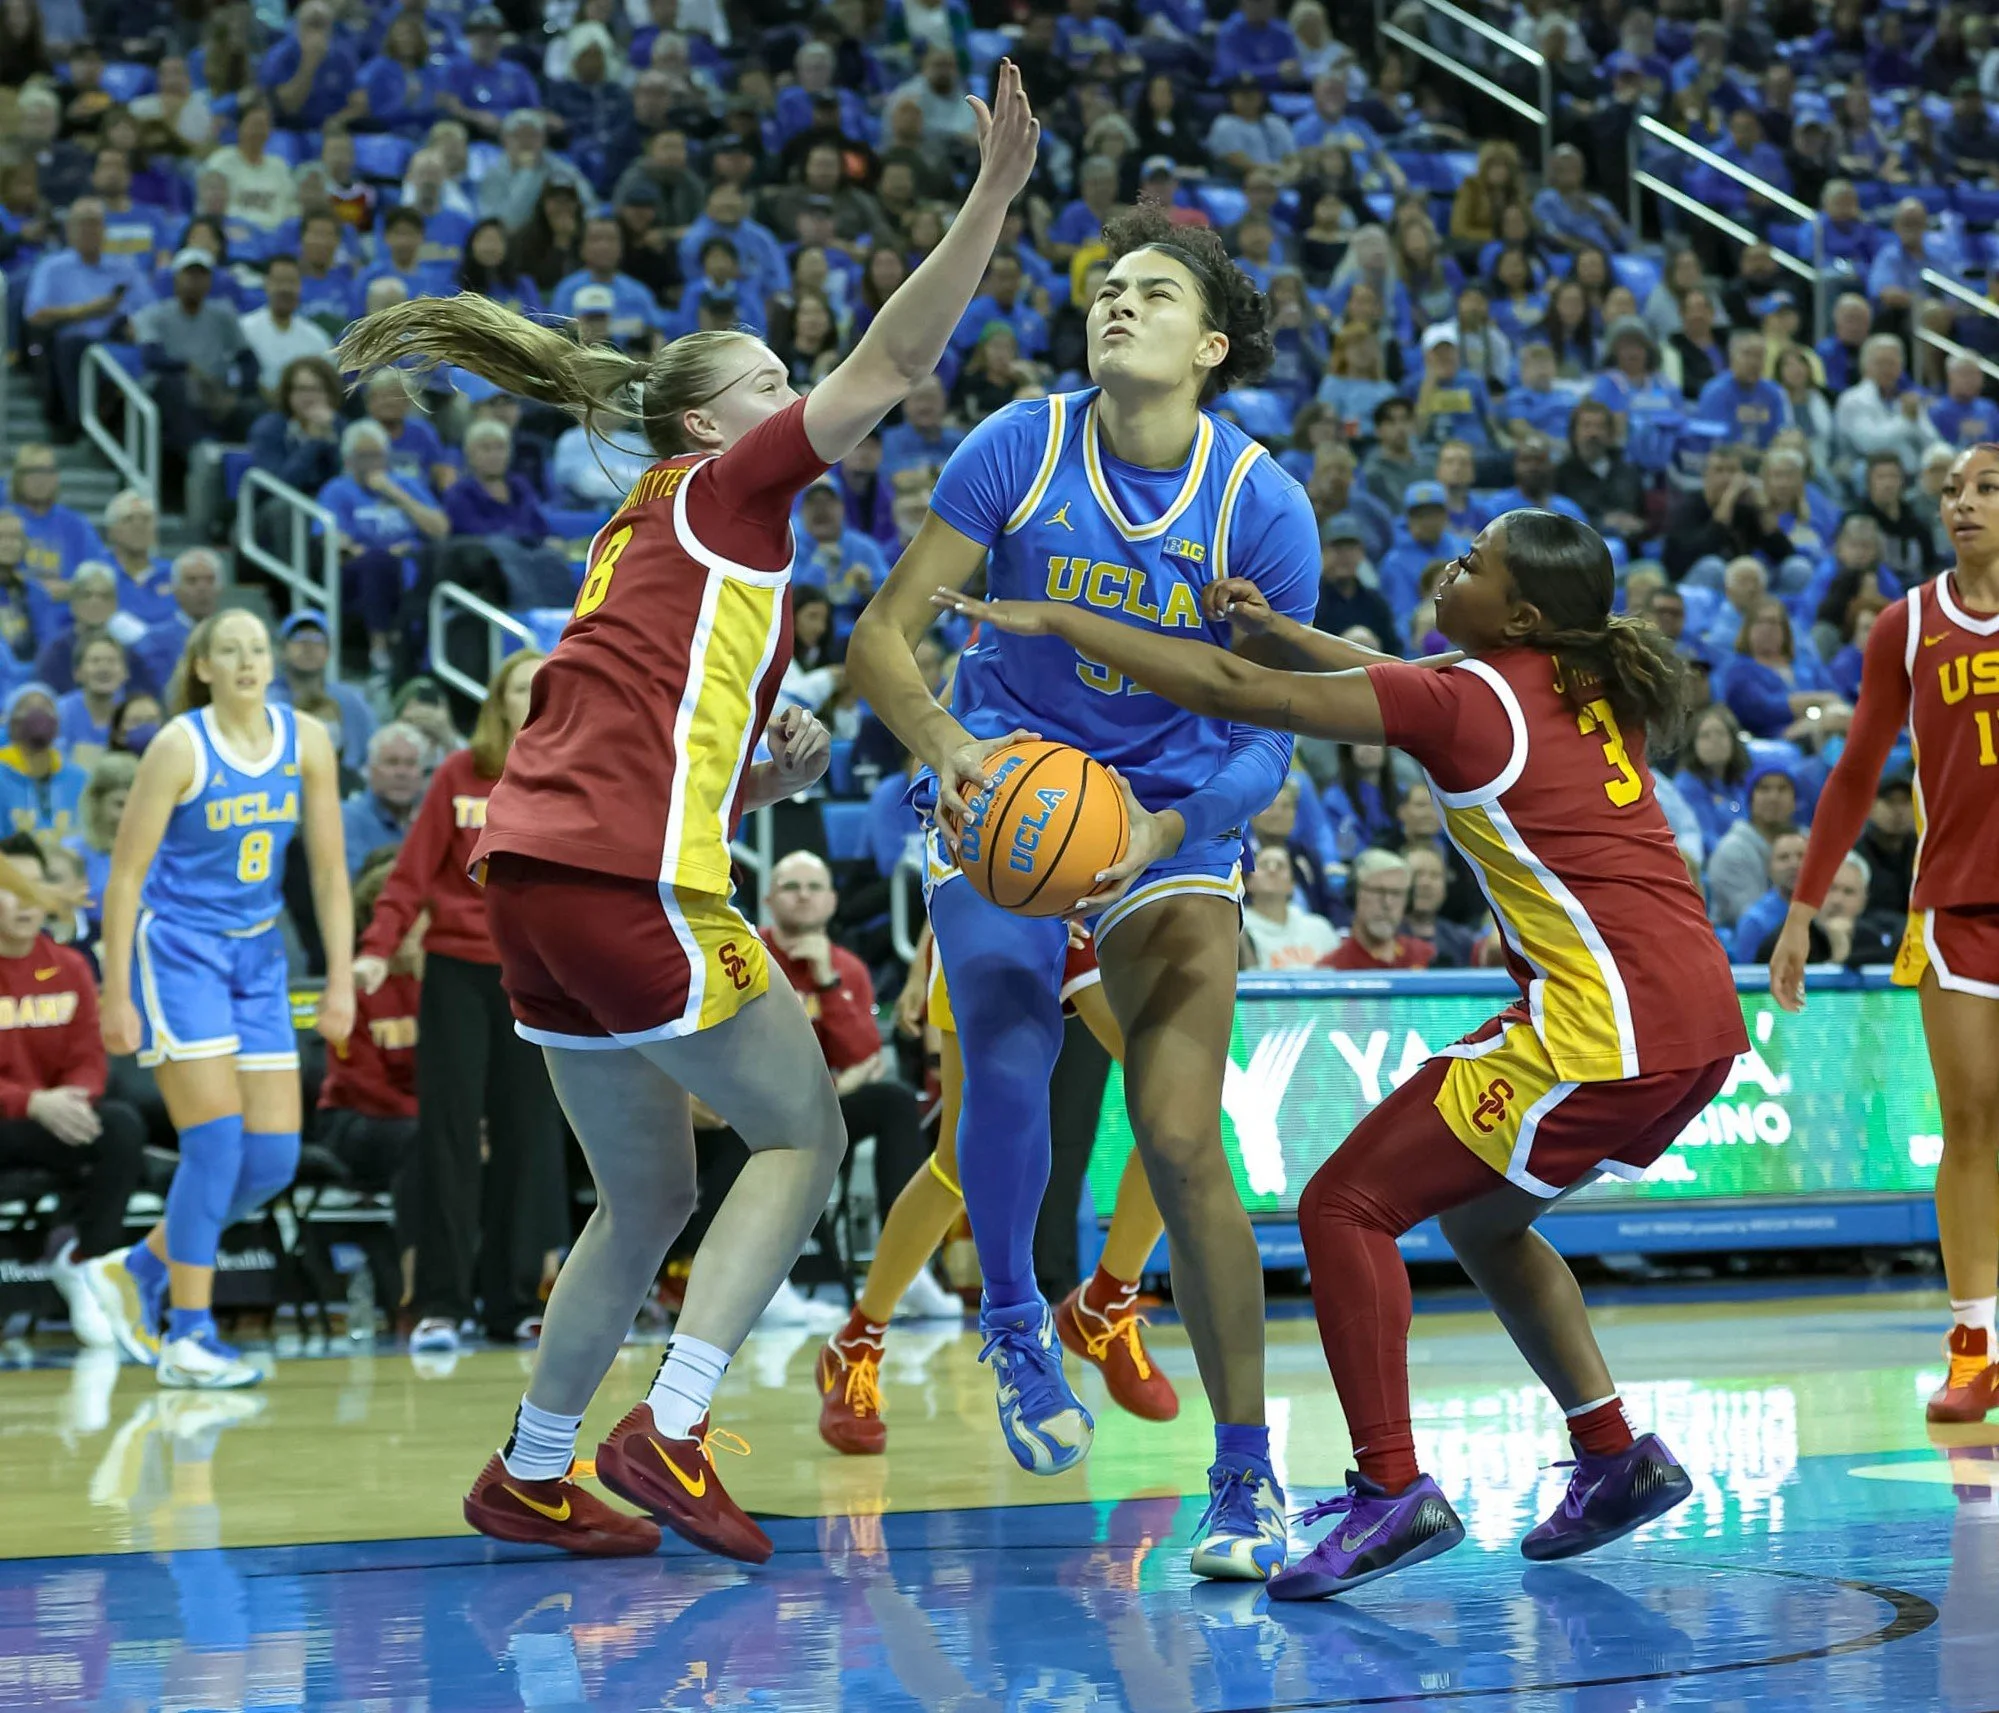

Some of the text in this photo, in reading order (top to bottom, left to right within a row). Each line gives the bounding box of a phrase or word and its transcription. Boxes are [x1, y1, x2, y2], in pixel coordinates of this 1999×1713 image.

[575, 524, 634, 619] 8
[1045, 556, 1202, 628] UCLA
[1577, 698, 1643, 808] 3
[1974, 710, 1999, 766] 1
[237, 830, 273, 884] 8
[1009, 788, 1069, 874] UCLA
[1672, 1101, 1791, 1146] SINO
